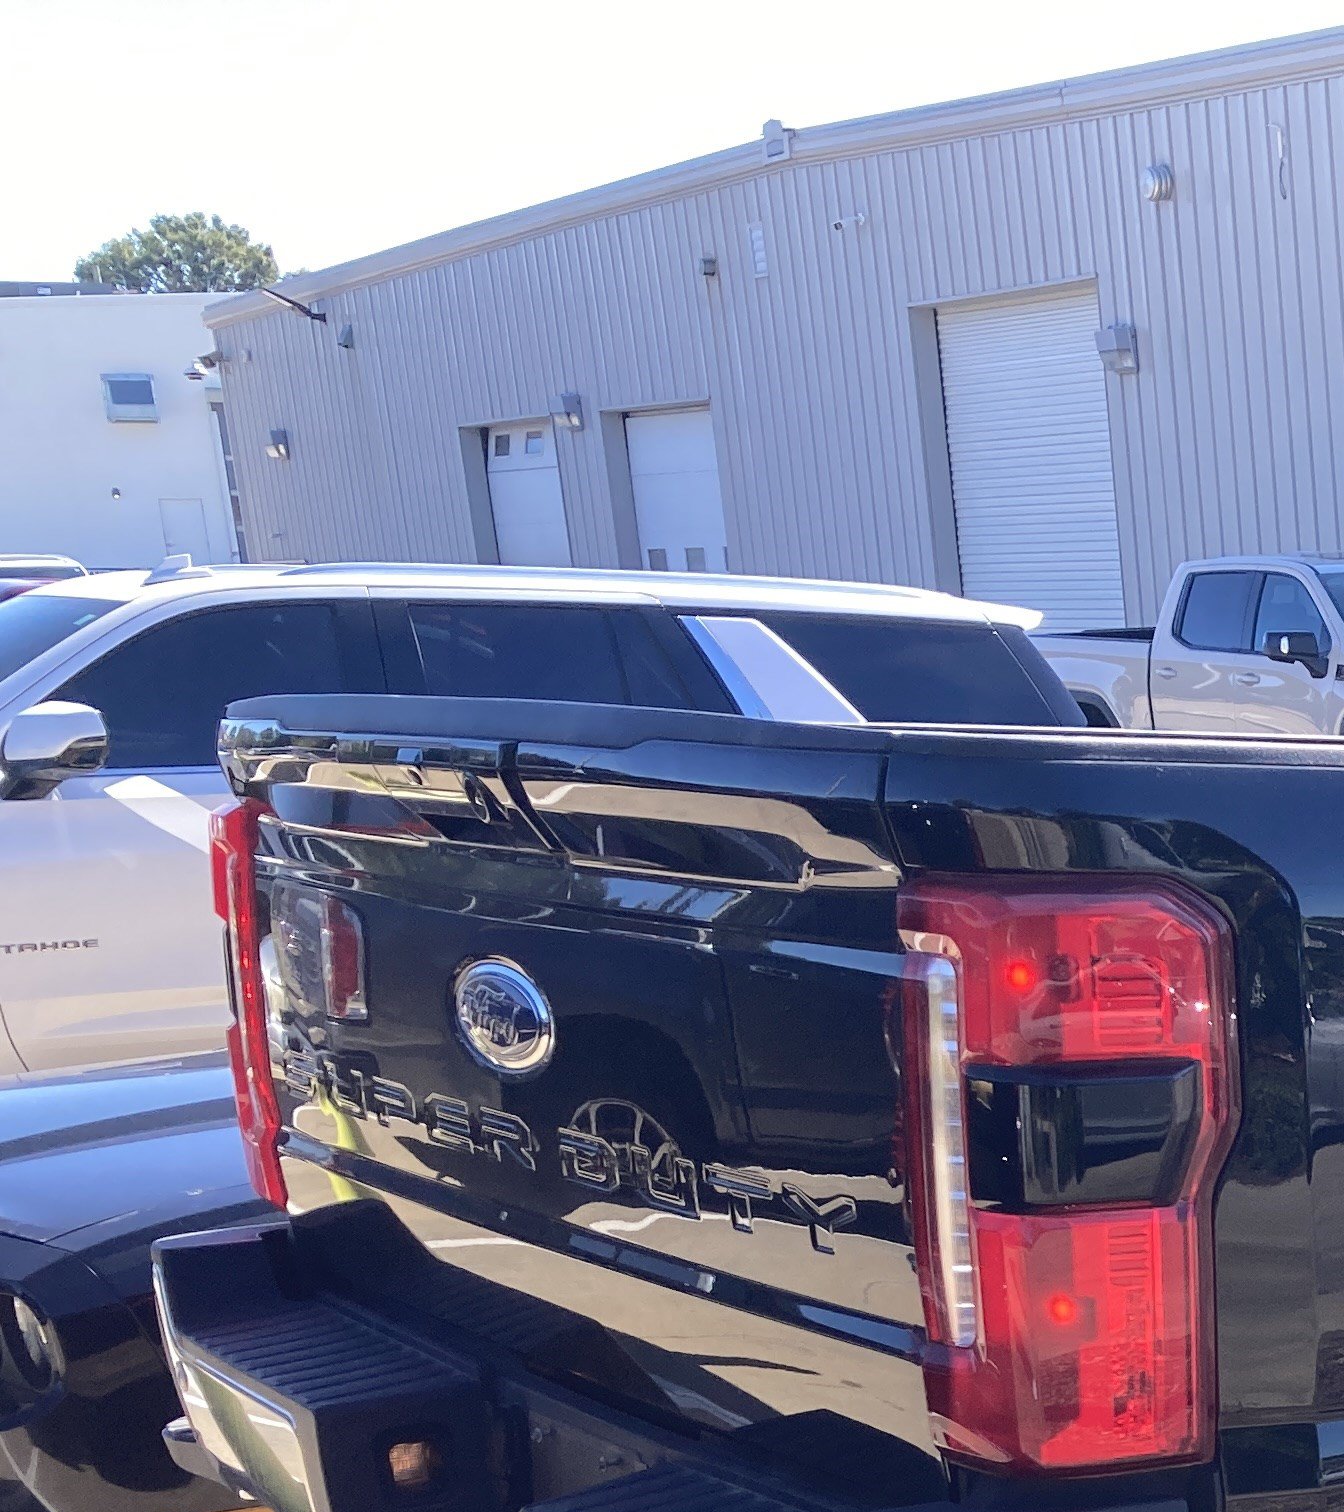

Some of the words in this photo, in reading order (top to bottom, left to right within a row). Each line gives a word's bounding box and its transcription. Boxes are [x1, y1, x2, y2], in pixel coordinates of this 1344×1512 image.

[0, 937, 100, 954] TAHOE
[282, 1048, 540, 1172] SUPER
[556, 1126, 857, 1255] DUTY
